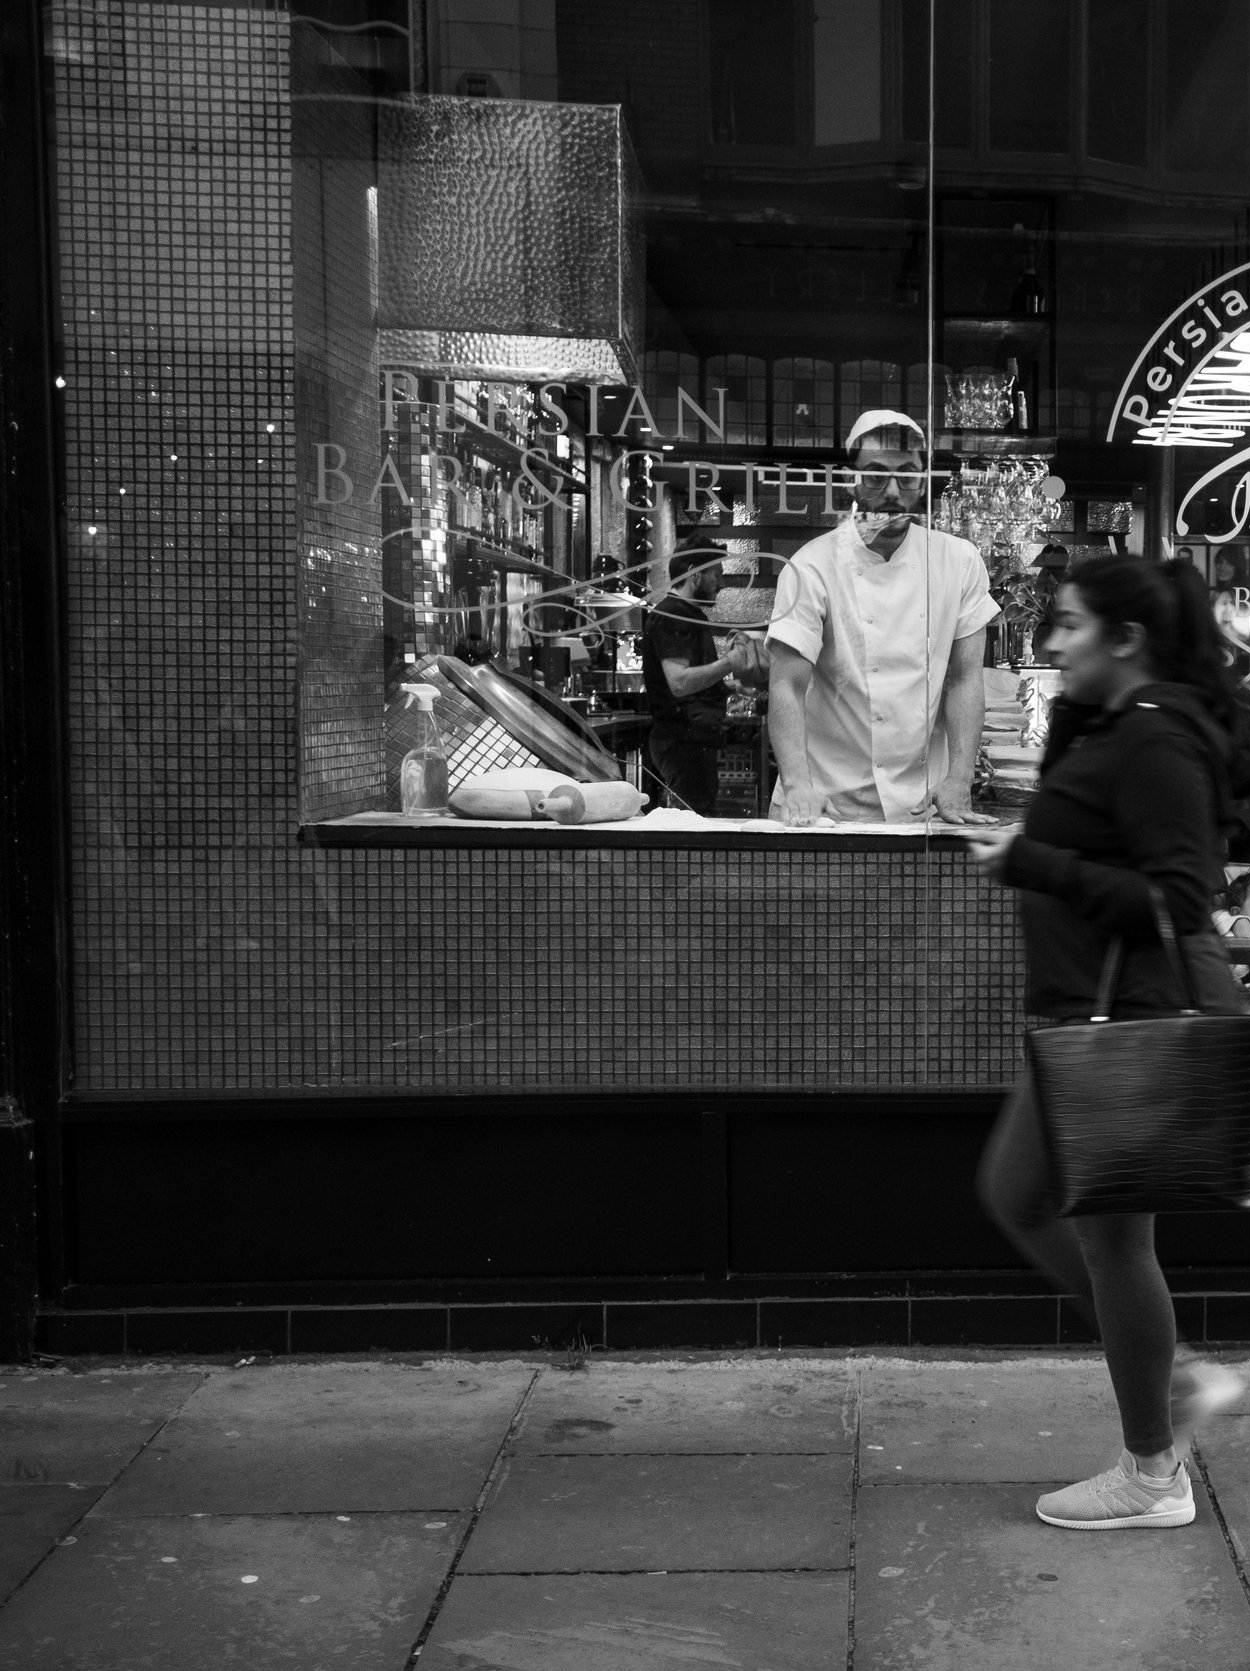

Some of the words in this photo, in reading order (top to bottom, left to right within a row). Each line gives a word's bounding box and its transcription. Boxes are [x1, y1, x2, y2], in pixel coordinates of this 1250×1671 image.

[378, 369, 729, 440] PERSIAN
[312, 443, 478, 507] BAR
[512, 448, 573, 510] &
[609, 450, 856, 515] GRILL
